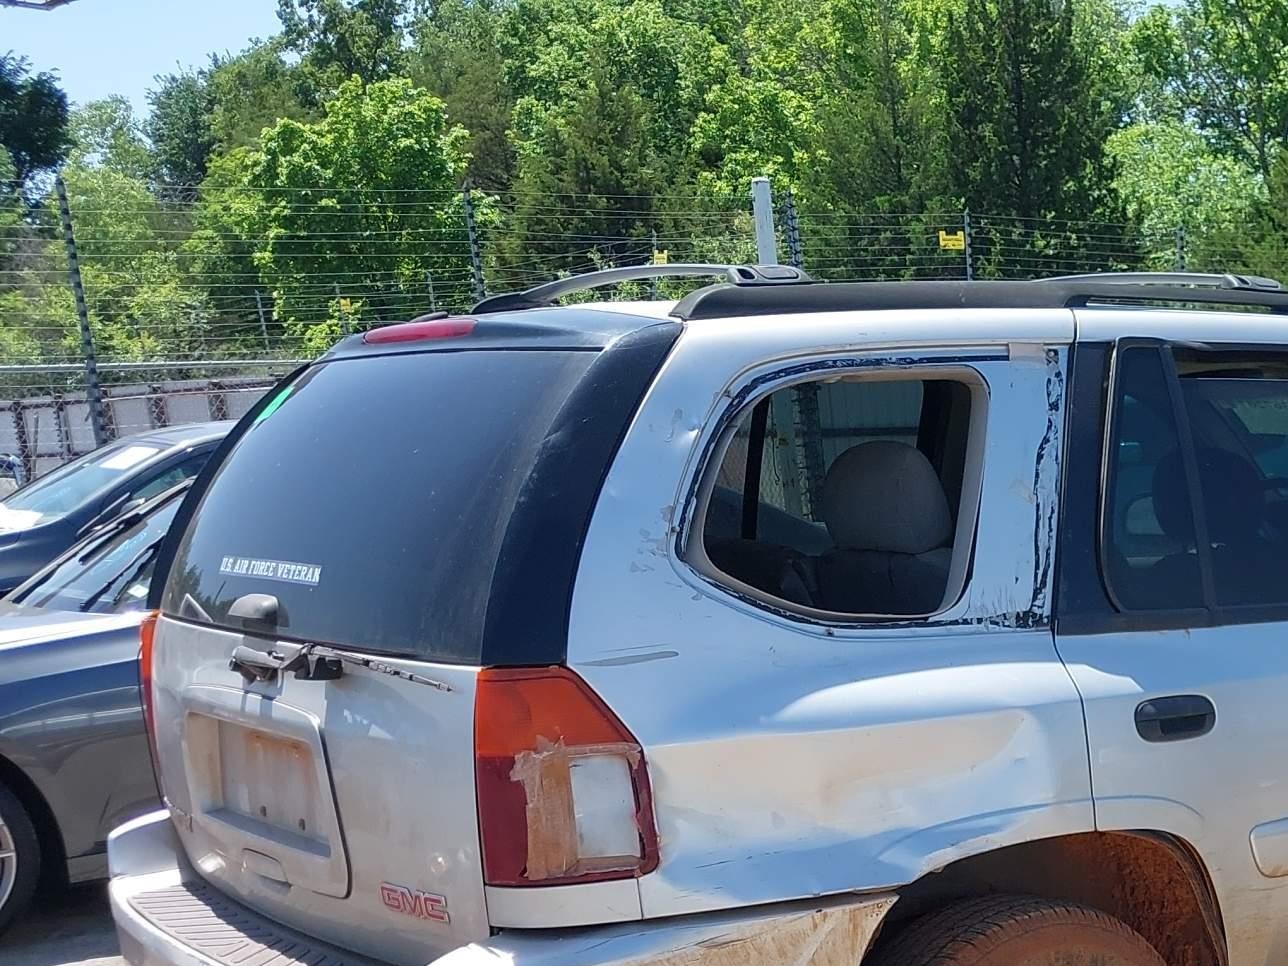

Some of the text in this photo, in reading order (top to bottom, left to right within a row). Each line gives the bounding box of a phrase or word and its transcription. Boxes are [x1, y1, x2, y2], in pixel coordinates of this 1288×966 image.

[233, 559, 249, 574] AIR
[248, 560, 276, 577] FORCE
[277, 563, 322, 583] VETERAN
[380, 881, 450, 924] GMC
